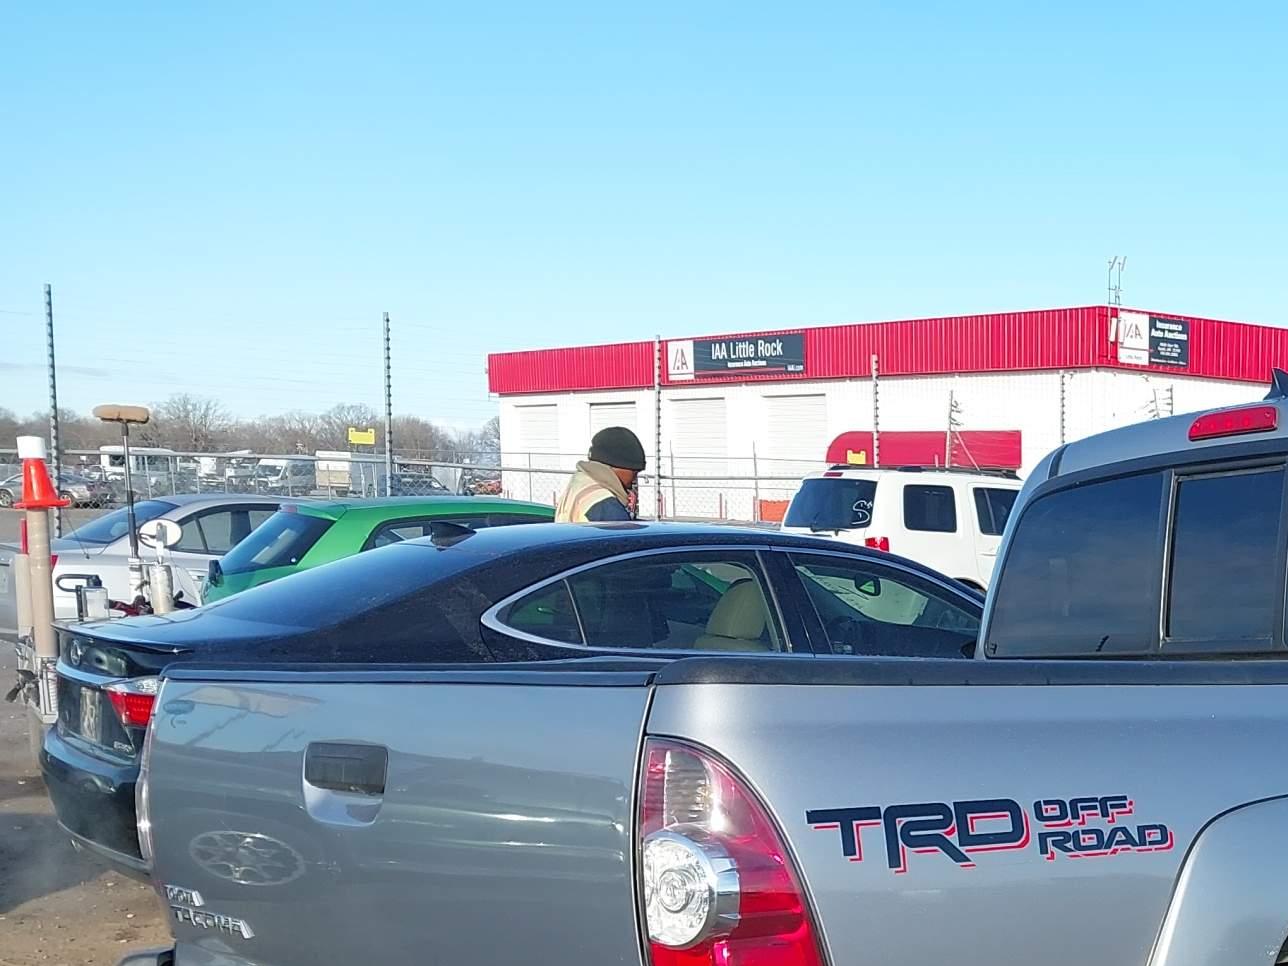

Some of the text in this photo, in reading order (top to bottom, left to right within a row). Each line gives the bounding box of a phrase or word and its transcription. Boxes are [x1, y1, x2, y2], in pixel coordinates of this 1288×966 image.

[711, 339, 783, 359] IAA Little Rock
[1032, 795, 1134, 827] OFF
[805, 798, 1031, 874] TRD
[1037, 824, 1175, 861] ROAD
